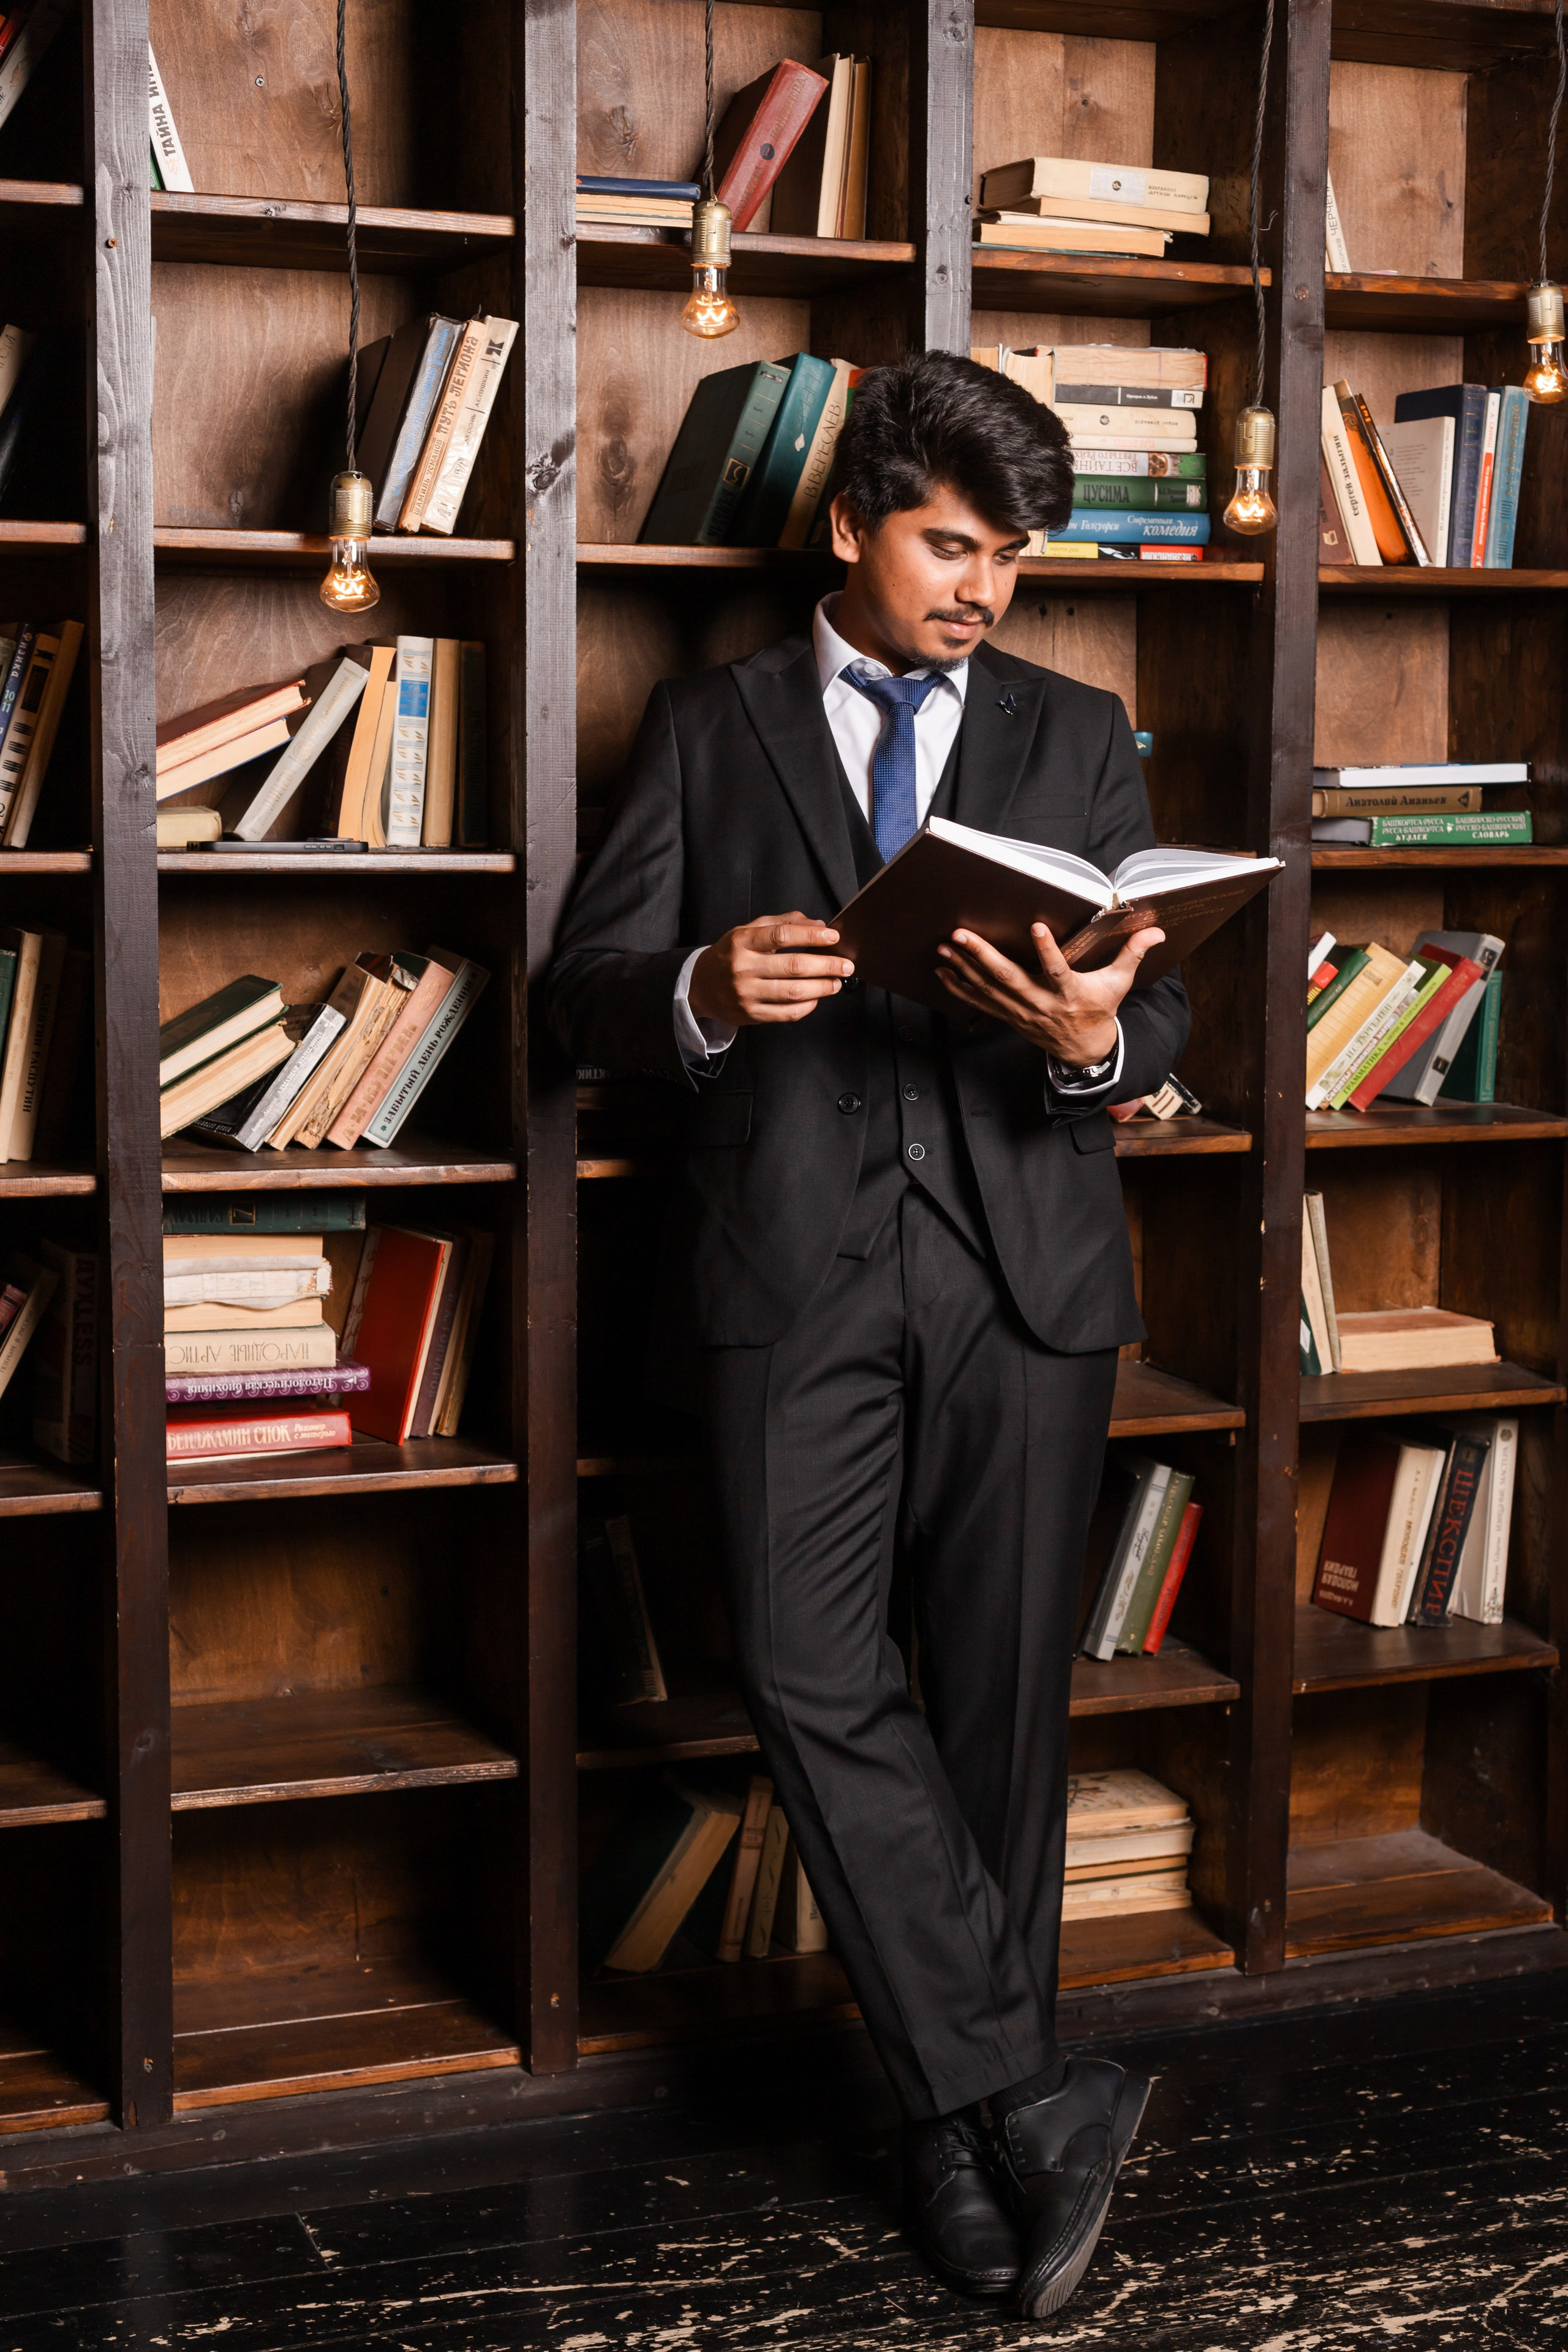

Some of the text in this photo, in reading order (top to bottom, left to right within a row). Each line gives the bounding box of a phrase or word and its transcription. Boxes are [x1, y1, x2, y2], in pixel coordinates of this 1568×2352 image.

[150, 104, 176, 156] ТАЙНА
[436, 334, 479, 435] ПУТЬ ЛЕГИОНА
[412, 438, 443, 515] ШАМИЛЬ УСМАНОВ
[1116, 461, 1137, 472] ВСЕ
[1332, 434, 1361, 516] сергей залыгин
[1082, 484, 1131, 503] ЦУСИМА
[1080, 519, 1119, 531] Голсуорси
[1142, 518, 1198, 537] комедия
[1126, 514, 1173, 526] Современная
[10, 631, 33, 677] Физика
[1, 701, 10, 712] 11
[4, 689, 15, 701] 10
[1346, 796, 1397, 807] Анатолий
[1400, 795, 1447, 804] Ананьев
[1472, 830, 1509, 839] СЛОВАРЬ
[382, 978, 474, 1125] ЗАБЫТЫЙ ДЕНЬ РОЖДЕНИЯ
[22, 1050, 40, 1113] РАСПУТИН
[250, 1117, 263, 1133] Борис
[276, 1065, 300, 1095] АЛМАЗНАЯ
[296, 1030, 324, 1065] КОЛЕСНИЦА
[1324, 1070, 1352, 1102] Секреты
[1349, 1036, 1380, 1073] денежной
[1343, 1046, 1385, 1095] ГРАММАТИКА
[166, 1341, 308, 1364] НАРОДНЫЕ АРТИС
[187, 1376, 331, 1393] Патологическая биохимия
[167, 1423, 292, 1451] БЕНДЖАМИН СПОК
[294, 1423, 327, 1433] Разговор
[300, 1428, 337, 1440] матерью
[1398, 1520, 1413, 1564] МОЛОДАЯ
[1423, 1468, 1474, 1616] ШЕКСПИР
[1390, 1568, 1403, 1609] ГВАРДИЯ
